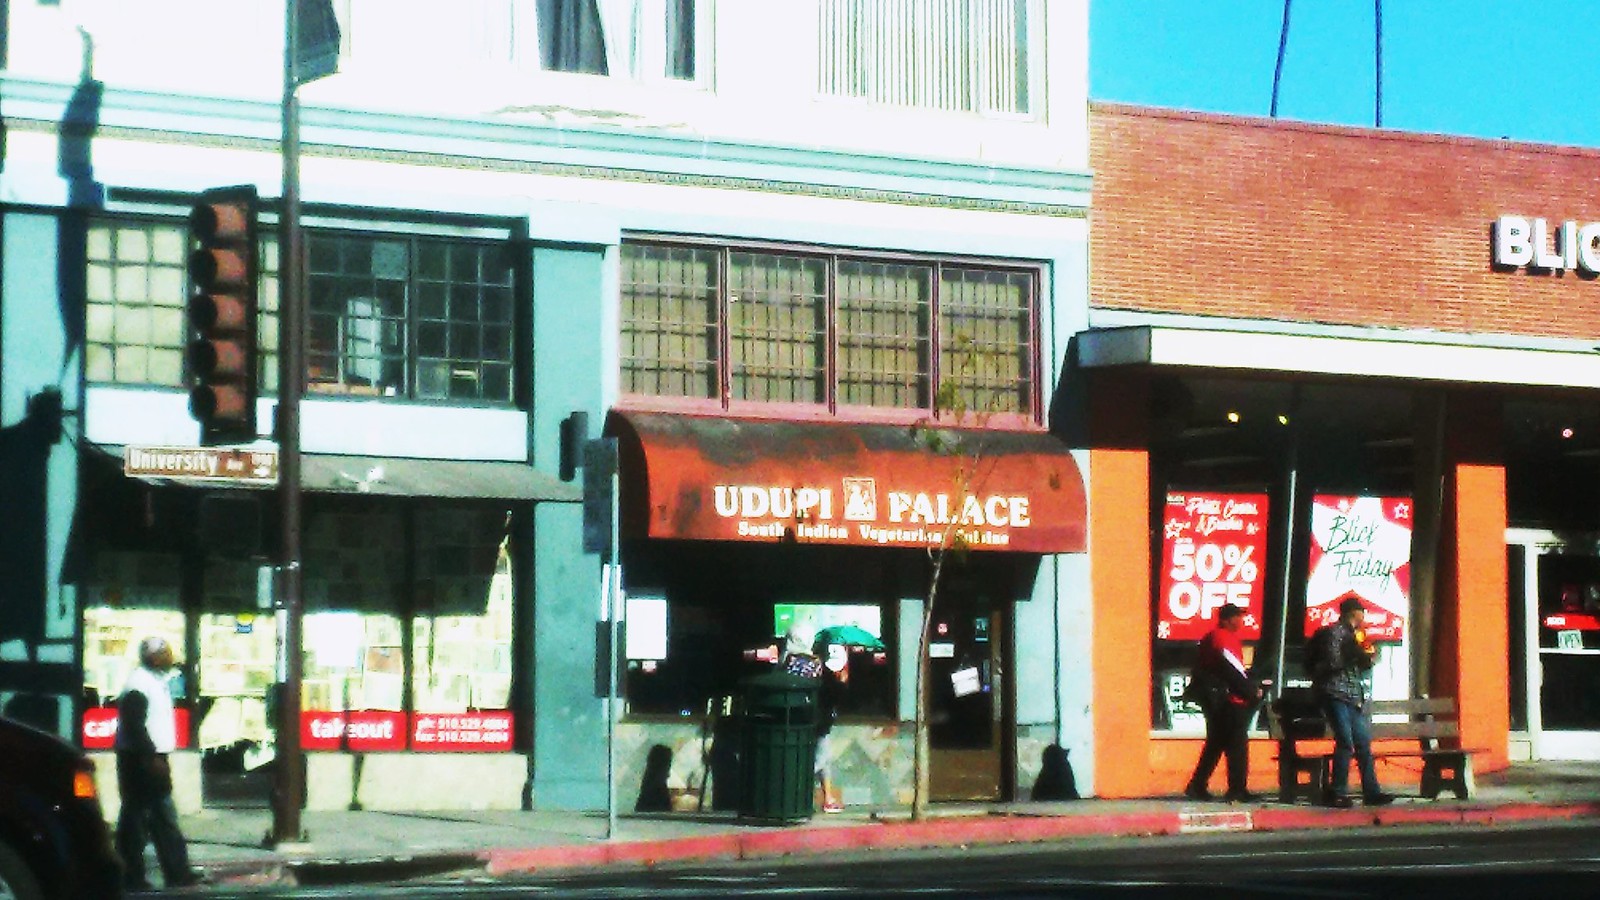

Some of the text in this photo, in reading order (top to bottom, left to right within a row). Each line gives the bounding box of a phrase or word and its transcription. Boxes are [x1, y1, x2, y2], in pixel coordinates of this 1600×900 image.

[130, 448, 219, 476] University
[713, 484, 1031, 528] UDUPI PALACE
[737, 520, 785, 537] South
[797, 522, 849, 540] Indian
[1321, 515, 1379, 554] Blick
[1170, 543, 1258, 583] 50%
[1333, 548, 1395, 594] Friday
[1168, 581, 1253, 620] OFF
[310, 717, 394, 739] takeout
